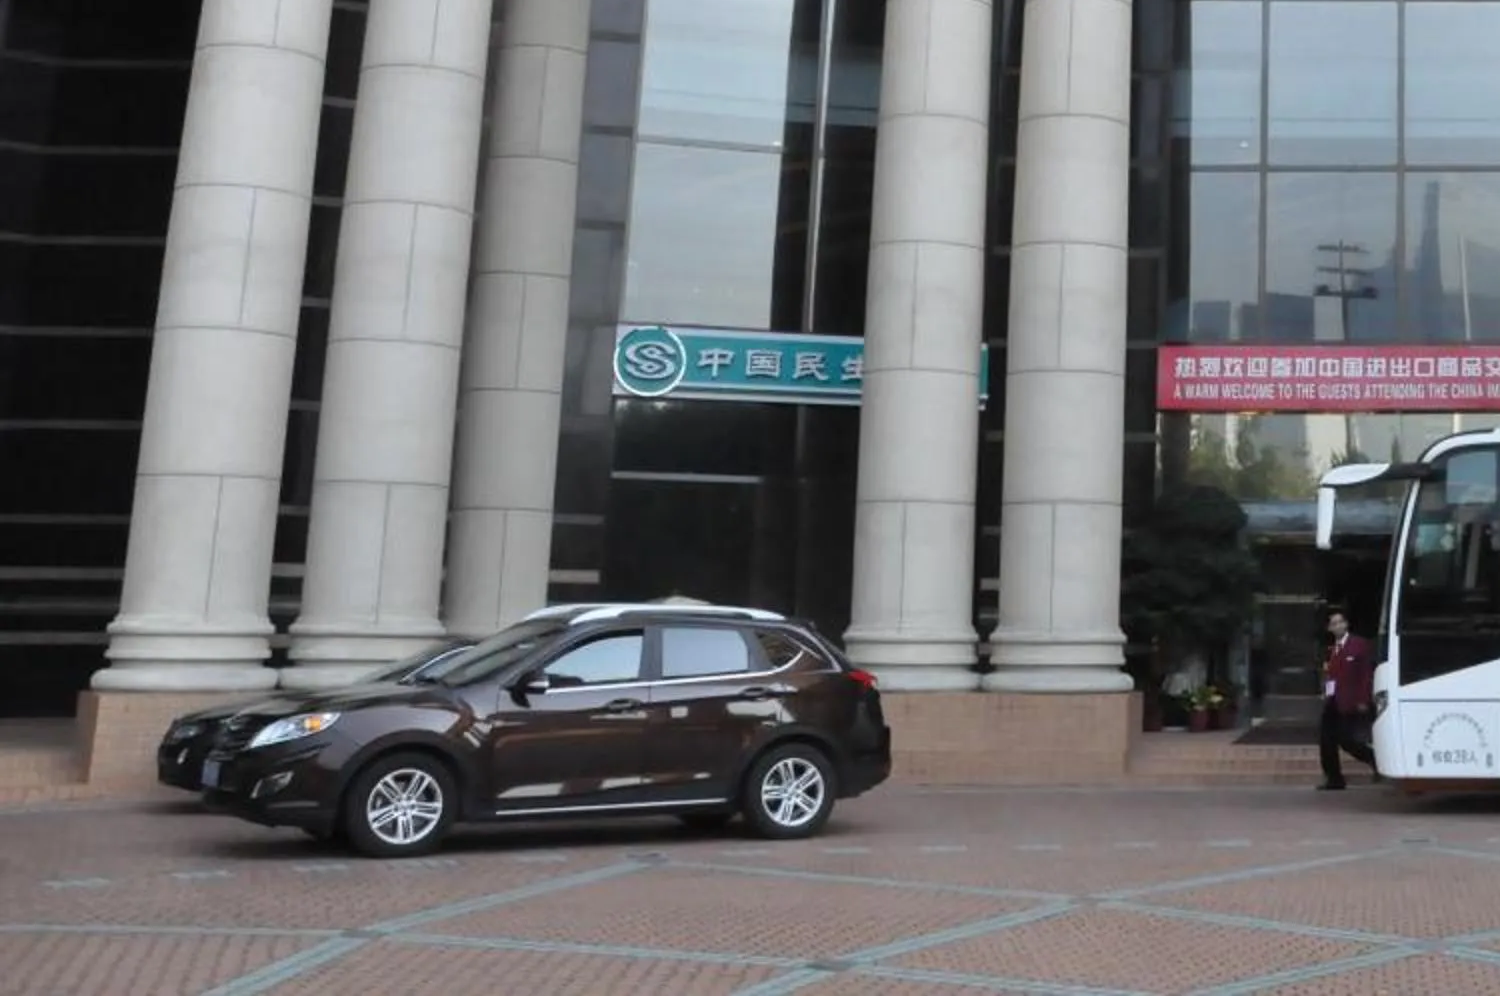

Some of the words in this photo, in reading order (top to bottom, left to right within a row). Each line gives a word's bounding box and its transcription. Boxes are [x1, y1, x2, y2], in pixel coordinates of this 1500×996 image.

[1185, 384, 1219, 399] WARM
[1221, 384, 1275, 399] WELCOME
[1279, 384, 1294, 398] TO
[1296, 384, 1316, 399] THE
[1318, 384, 1361, 399] GUESTS
[1363, 384, 1425, 398] ATTENDING
[1429, 383, 1448, 398] THE
[1450, 383, 1484, 398] CHINA
